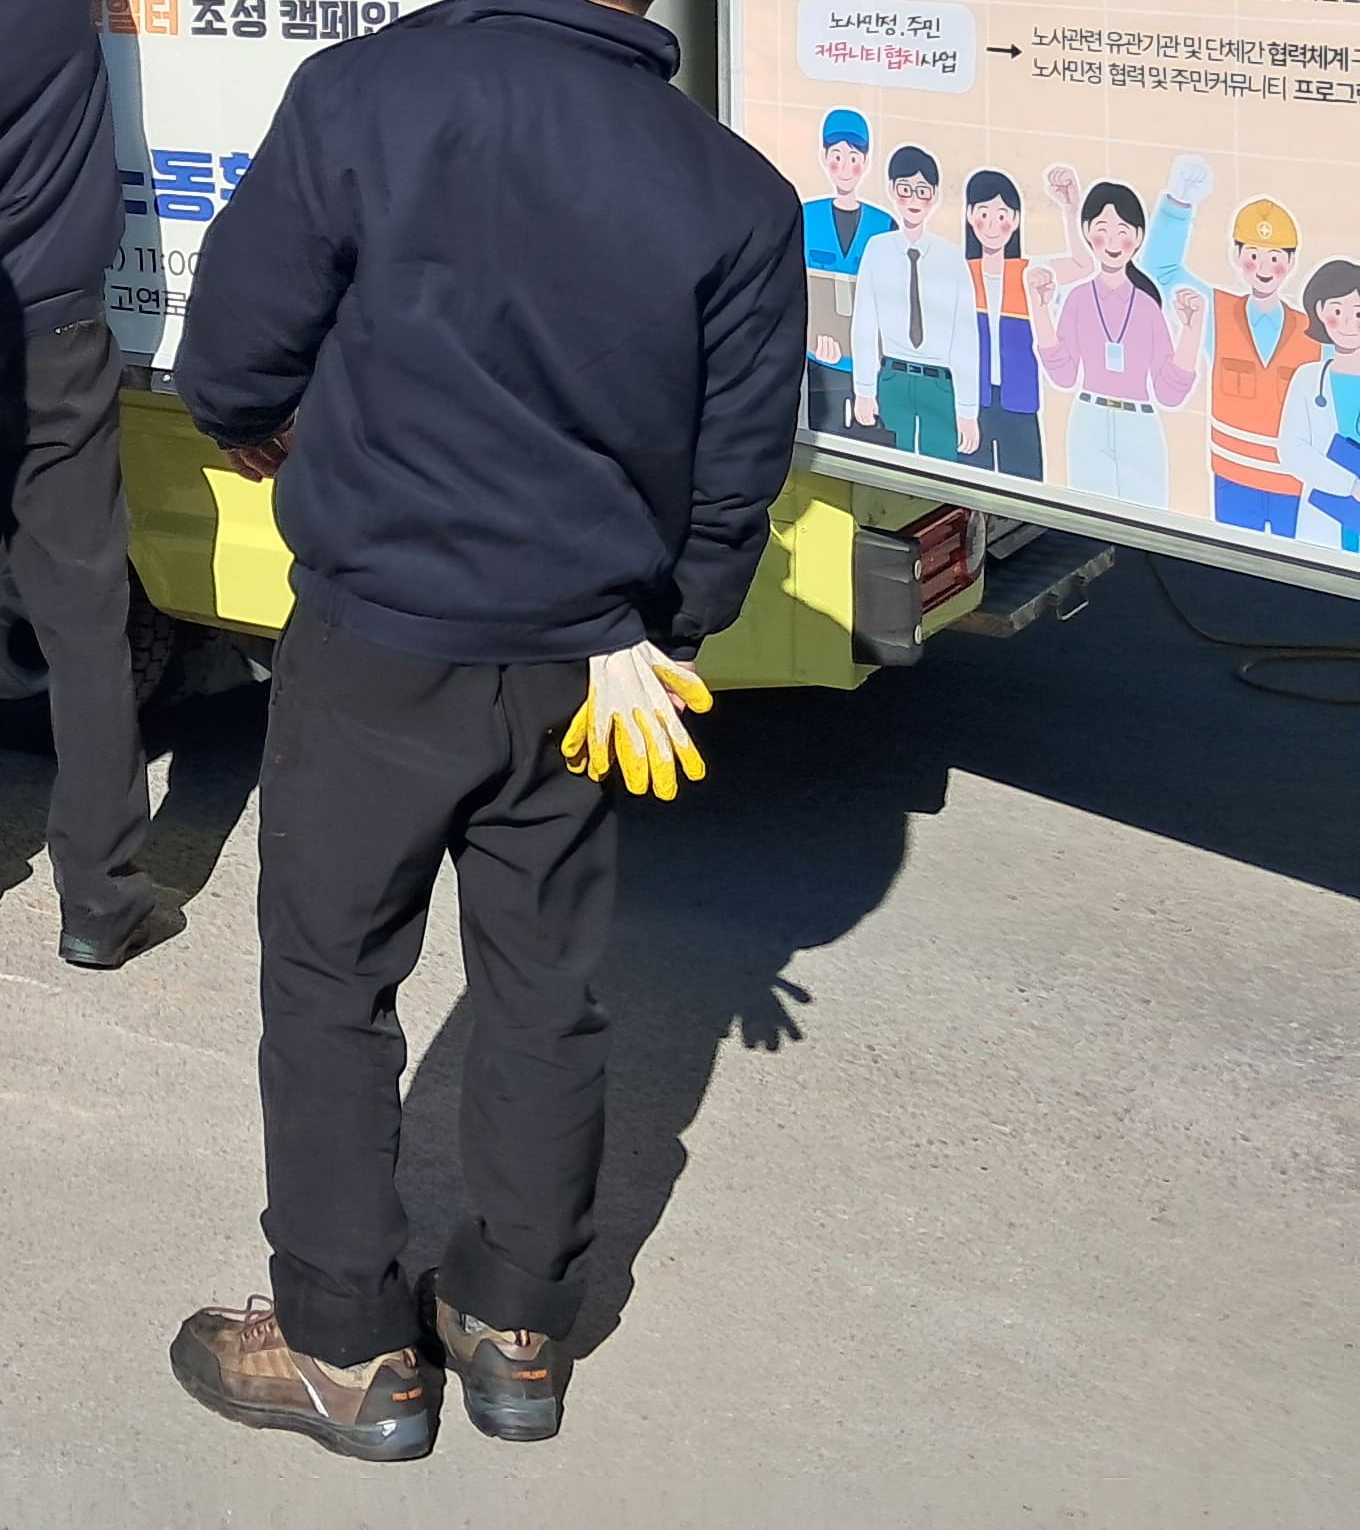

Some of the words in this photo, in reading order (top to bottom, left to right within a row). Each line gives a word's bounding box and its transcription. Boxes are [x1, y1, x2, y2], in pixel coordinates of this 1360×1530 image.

[815, 41, 881, 64] 커뮤니티
[883, 44, 957, 74] 협치사업
[1032, 27, 1102, 52] 노사관련
[1106, 31, 1181, 59] 유관기관
[1184, 36, 1202, 60] 및
[1205, 38, 1267, 65] 단체간
[1269, 42, 1349, 72] 협력체계
[1032, 58, 1102, 83] 노사민정
[1109, 62, 1146, 88] 협력
[1148, 65, 1168, 91] 및
[1171, 68, 1287, 102] 주민커뮤니티
